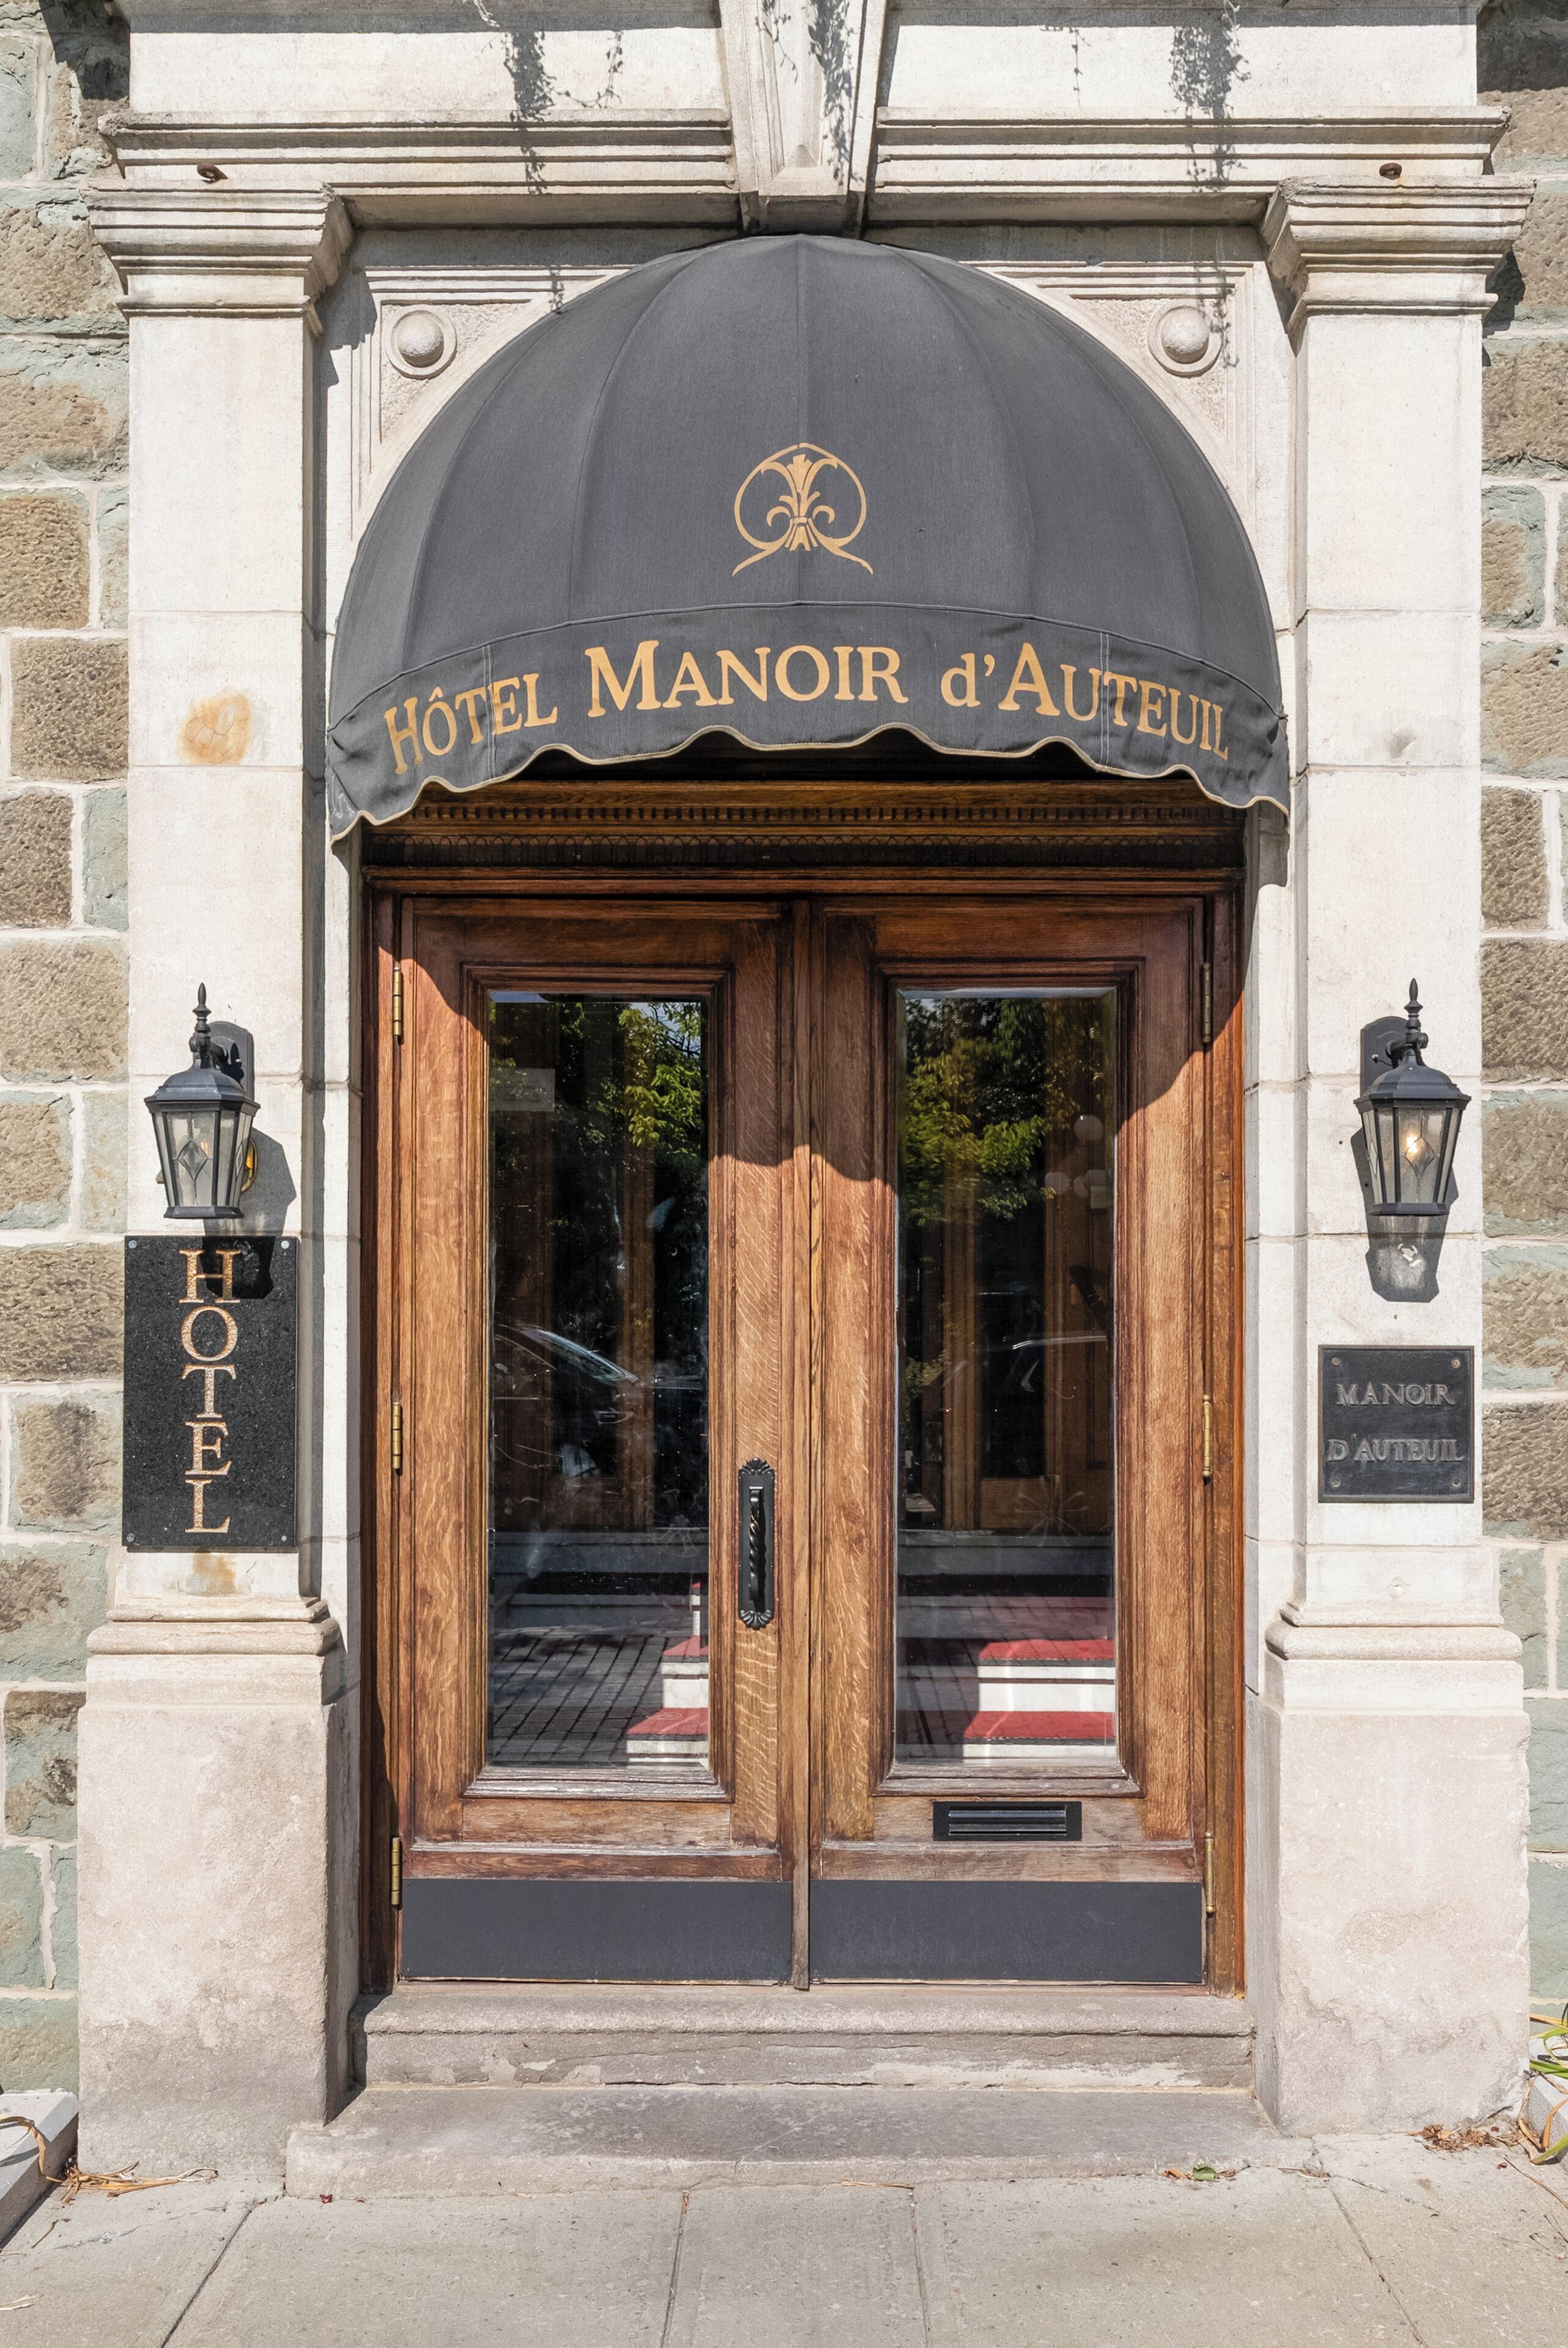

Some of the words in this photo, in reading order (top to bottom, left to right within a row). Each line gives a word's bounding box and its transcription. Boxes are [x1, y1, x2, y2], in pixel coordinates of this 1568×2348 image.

[384, 673, 558, 774] HÔTEL
[584, 639, 910, 718] MANOIR
[940, 642, 1229, 761] d'AUTEUIL
[179, 1249, 242, 1534] HOTEL
[1336, 1383, 1456, 1406] MANOIR
